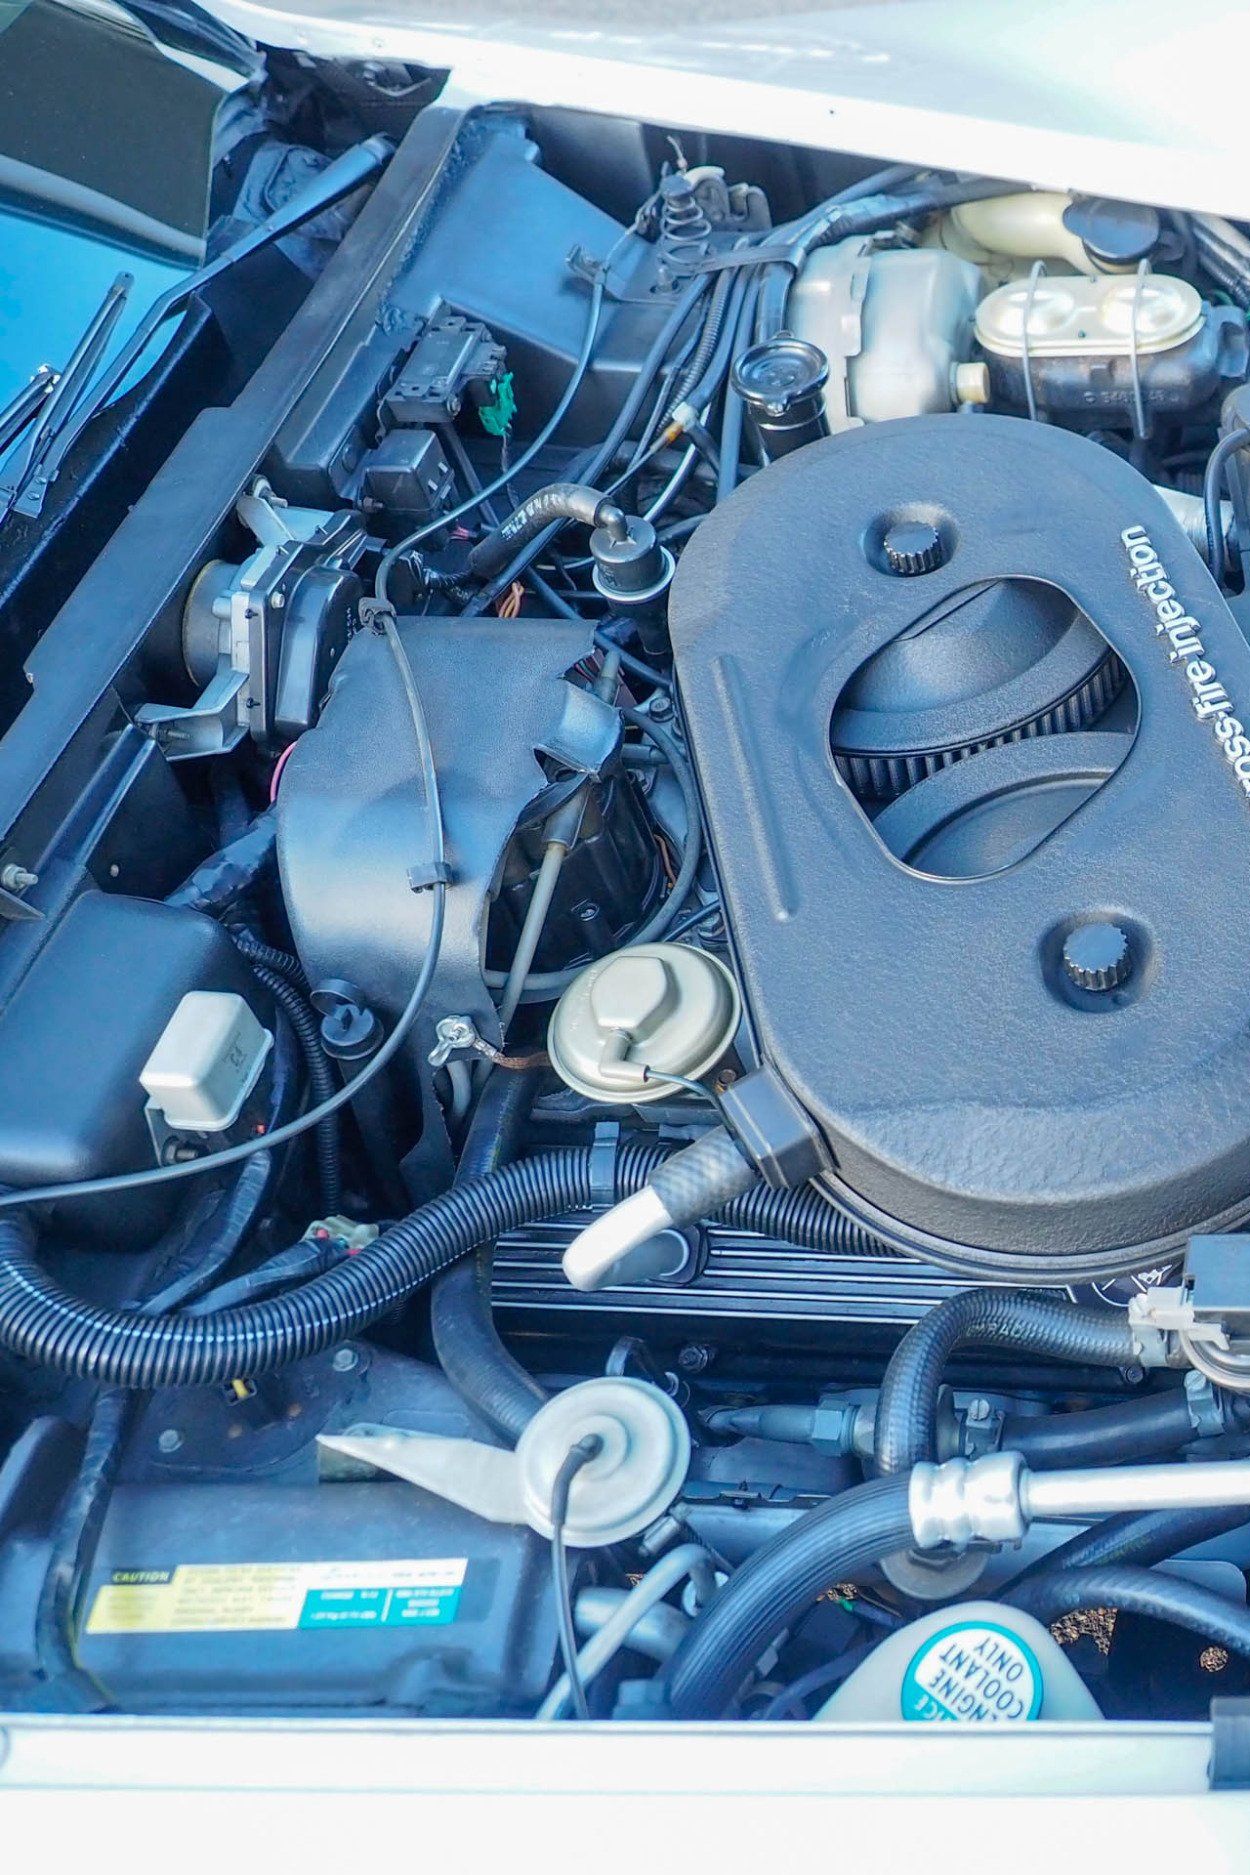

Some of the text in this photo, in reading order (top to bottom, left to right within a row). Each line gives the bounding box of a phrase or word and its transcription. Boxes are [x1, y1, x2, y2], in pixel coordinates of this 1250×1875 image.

[1120, 524, 1206, 662] injection
[112, 1571, 169, 1583] CAUTION
[938, 1643, 1024, 1720] COOLANT
[973, 1636, 1024, 1682] ONLY
[929, 1669, 998, 1721] NGINE
